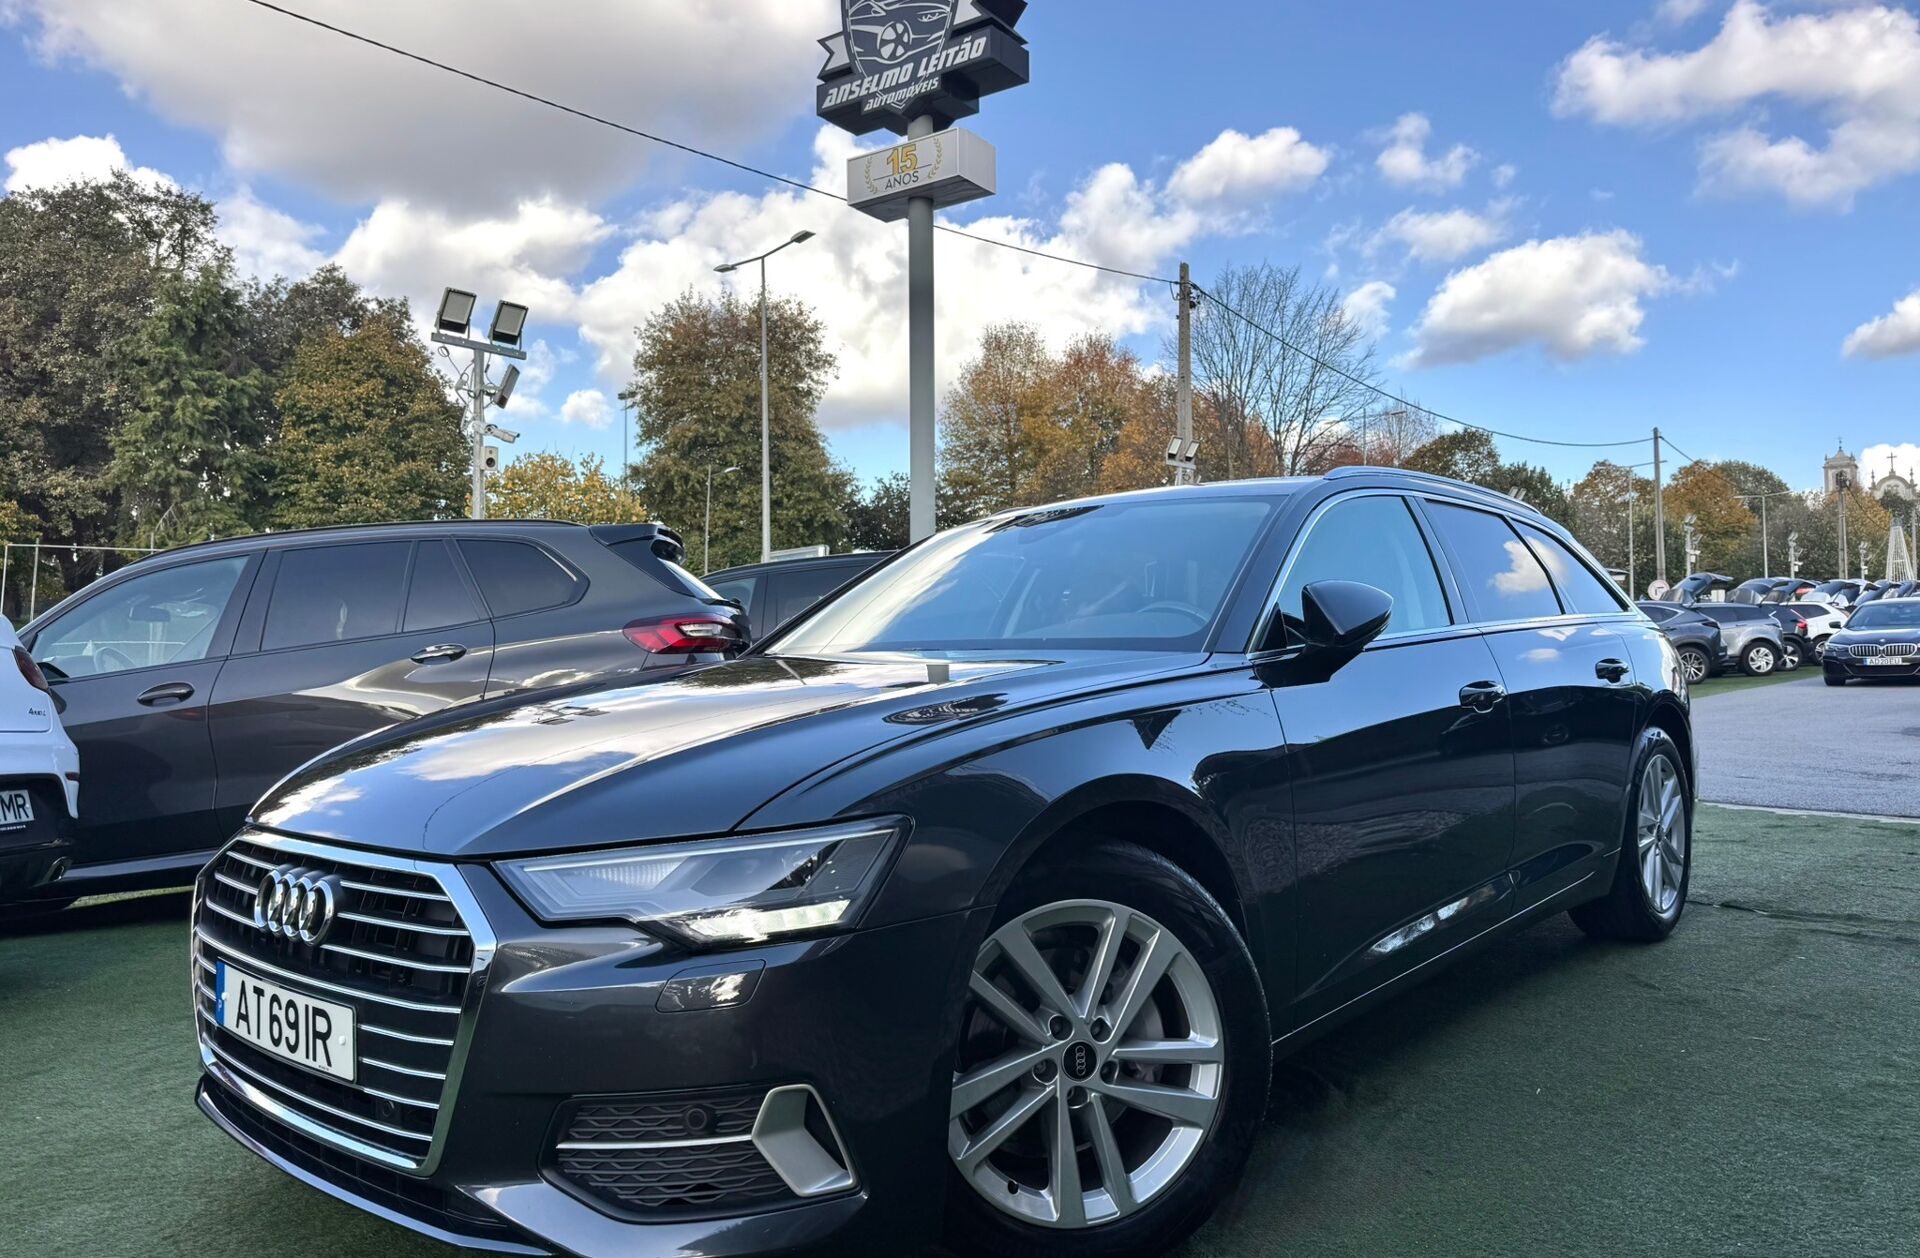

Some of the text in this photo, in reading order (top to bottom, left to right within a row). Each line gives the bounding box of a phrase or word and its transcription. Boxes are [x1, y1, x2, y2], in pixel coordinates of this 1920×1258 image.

[917, 35, 987, 77] LEITÃO
[886, 143, 918, 176] 15
[885, 171, 919, 190] ANOS
